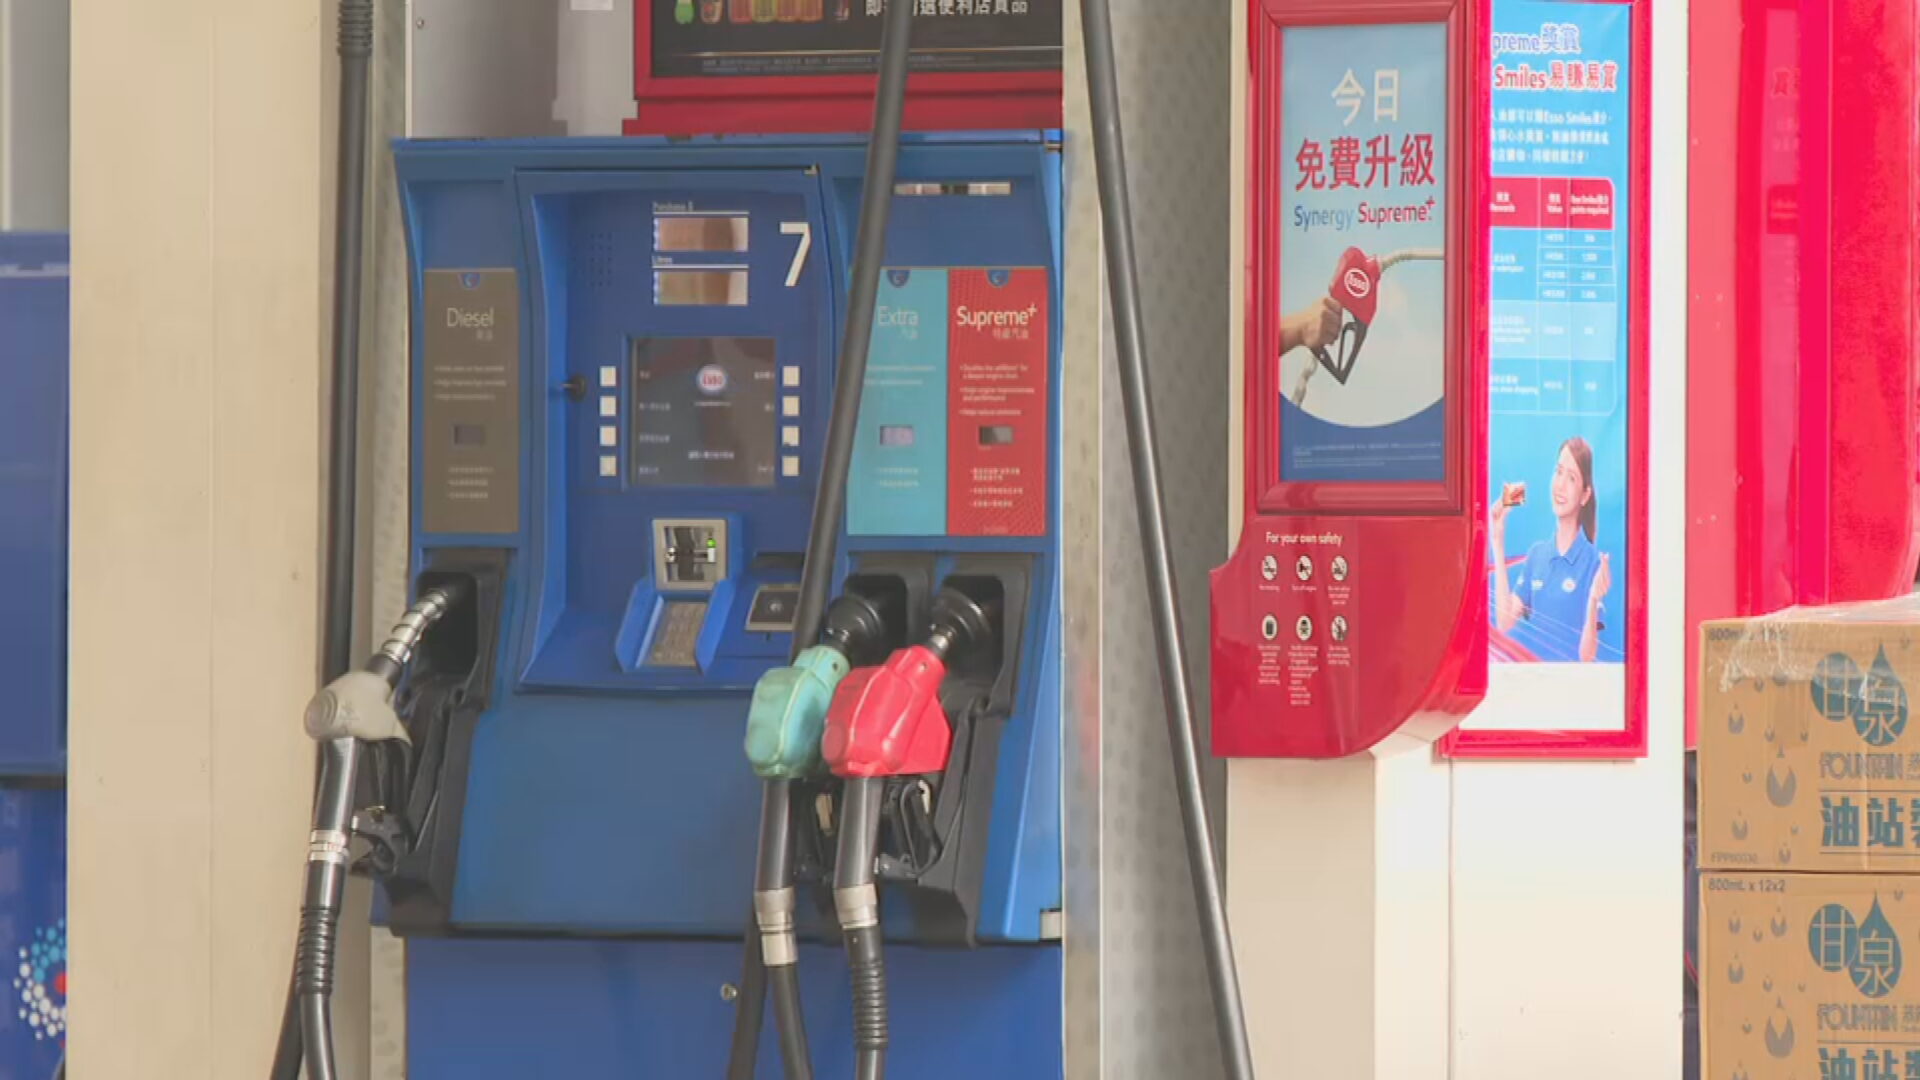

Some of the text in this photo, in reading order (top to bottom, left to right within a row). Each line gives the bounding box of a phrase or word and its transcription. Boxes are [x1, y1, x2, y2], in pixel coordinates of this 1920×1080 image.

[1495, 65, 1546, 89] Smiles
[1331, 68, 1398, 127] 今日
[1295, 133, 1435, 192] 免費升級
[1294, 205, 1354, 232] Synergy
[779, 221, 812, 287] 7
[446, 307, 495, 328] Diesel
[877, 306, 919, 326] Extra
[956, 302, 1039, 331] Supreme+
[1266, 531, 1343, 547] For your own safety
[1820, 752, 1904, 780] FOUNTAIN
[1759, 879, 1786, 892] 12x2
[1812, 906, 1895, 995] 甘泉
